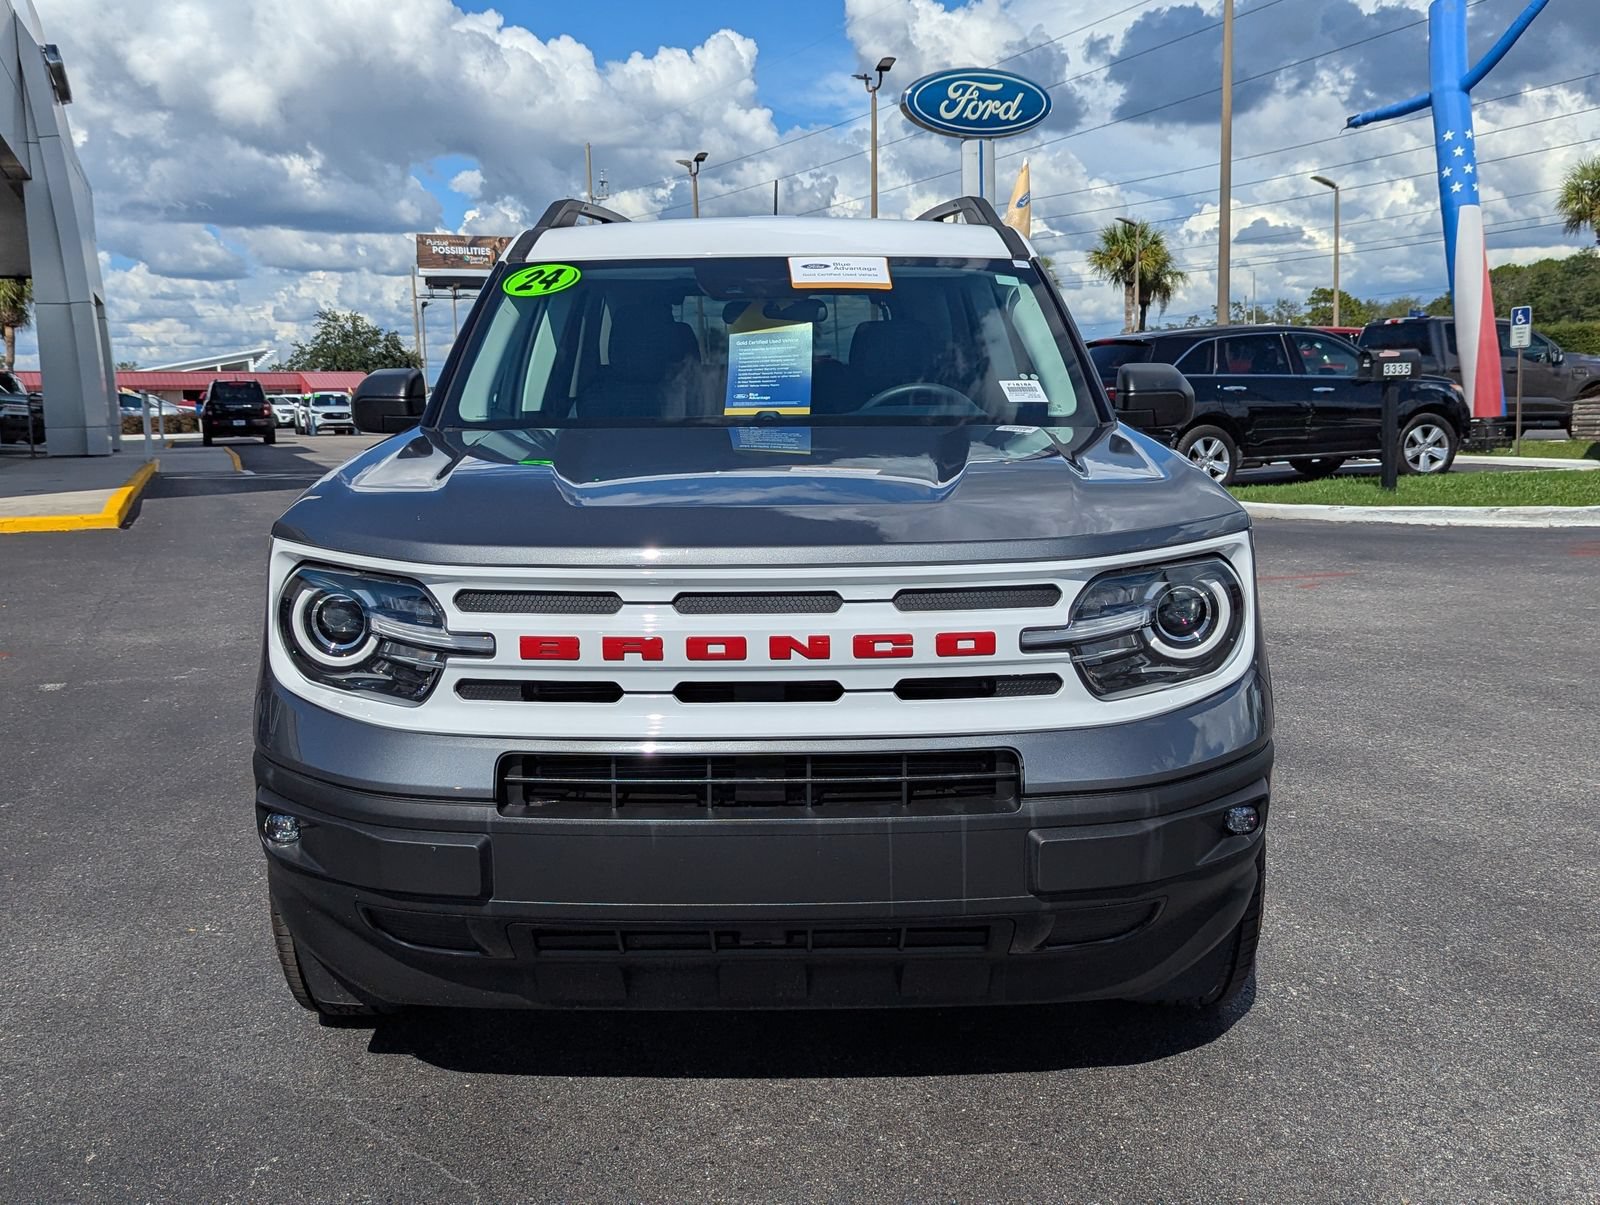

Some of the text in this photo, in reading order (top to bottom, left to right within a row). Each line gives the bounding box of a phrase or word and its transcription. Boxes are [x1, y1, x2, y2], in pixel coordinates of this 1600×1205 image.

[940, 80, 1024, 121] Ford
[432, 246, 491, 256] POSSIBILITIES
[514, 268, 567, 291] 24
[1384, 364, 1410, 374] 3335
[519, 631, 997, 661] BRONCO
